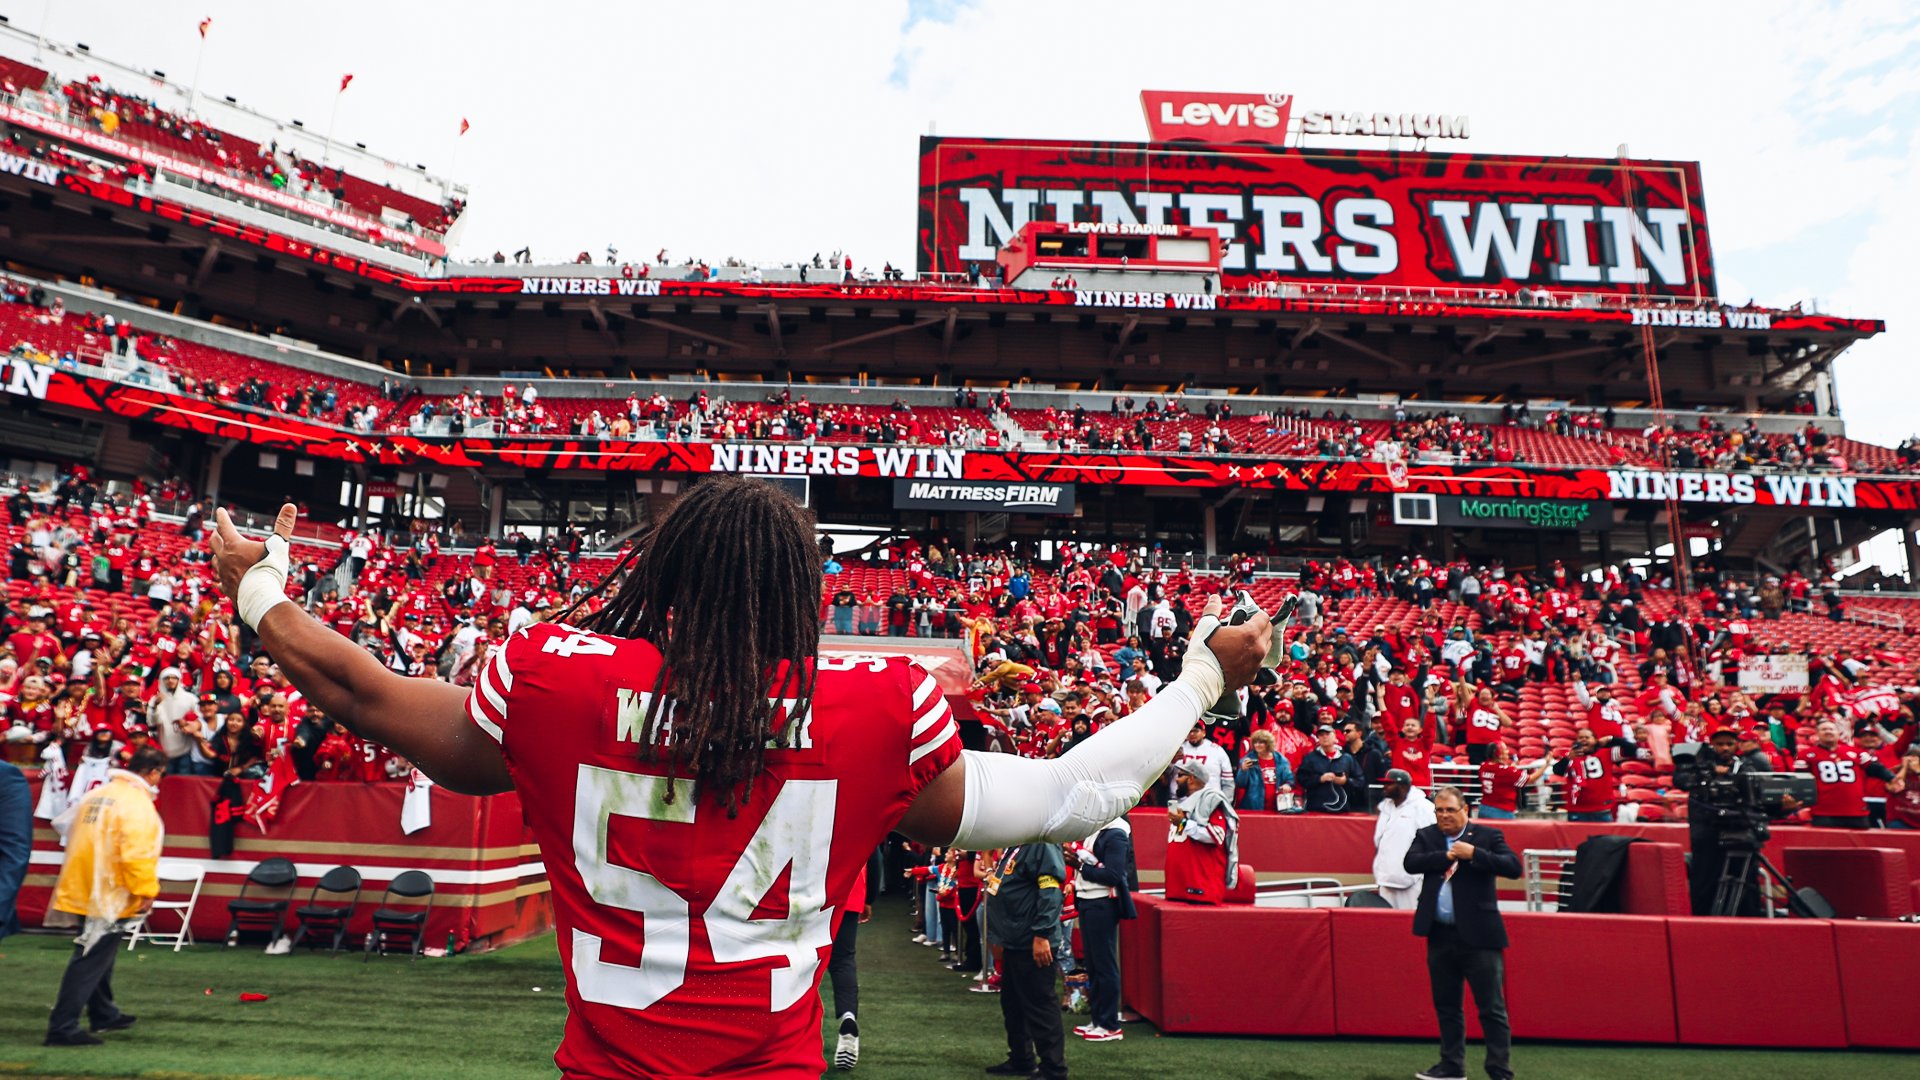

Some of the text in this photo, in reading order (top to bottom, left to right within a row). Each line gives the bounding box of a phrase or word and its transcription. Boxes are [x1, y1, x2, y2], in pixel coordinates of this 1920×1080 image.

[1303, 109, 1471, 139] STADIUM
[0, 149, 60, 186] WIN
[142, 149, 201, 180] INCLUDE
[330, 209, 357, 228] AND
[1120, 223, 1178, 236] STADIUM
[1431, 200, 1687, 285] WIN
[521, 277, 661, 296] NINERS WIN
[1074, 290, 1216, 310] NINERS WIN
[1631, 308, 1771, 330] NINERS WIN
[710, 444, 965, 479] NINERS WIN
[1607, 471, 1857, 508] NINERS WIN
[1461, 499, 1580, 525] MorningStar
[541, 633, 618, 658] 4
[1505, 656, 1520, 669] 97
[1472, 709, 1500, 731] 85
[1213, 726, 1236, 750] 54
[363, 743, 377, 762] 5
[1818, 760, 1856, 783] 85
[572, 763, 838, 1012] 54
